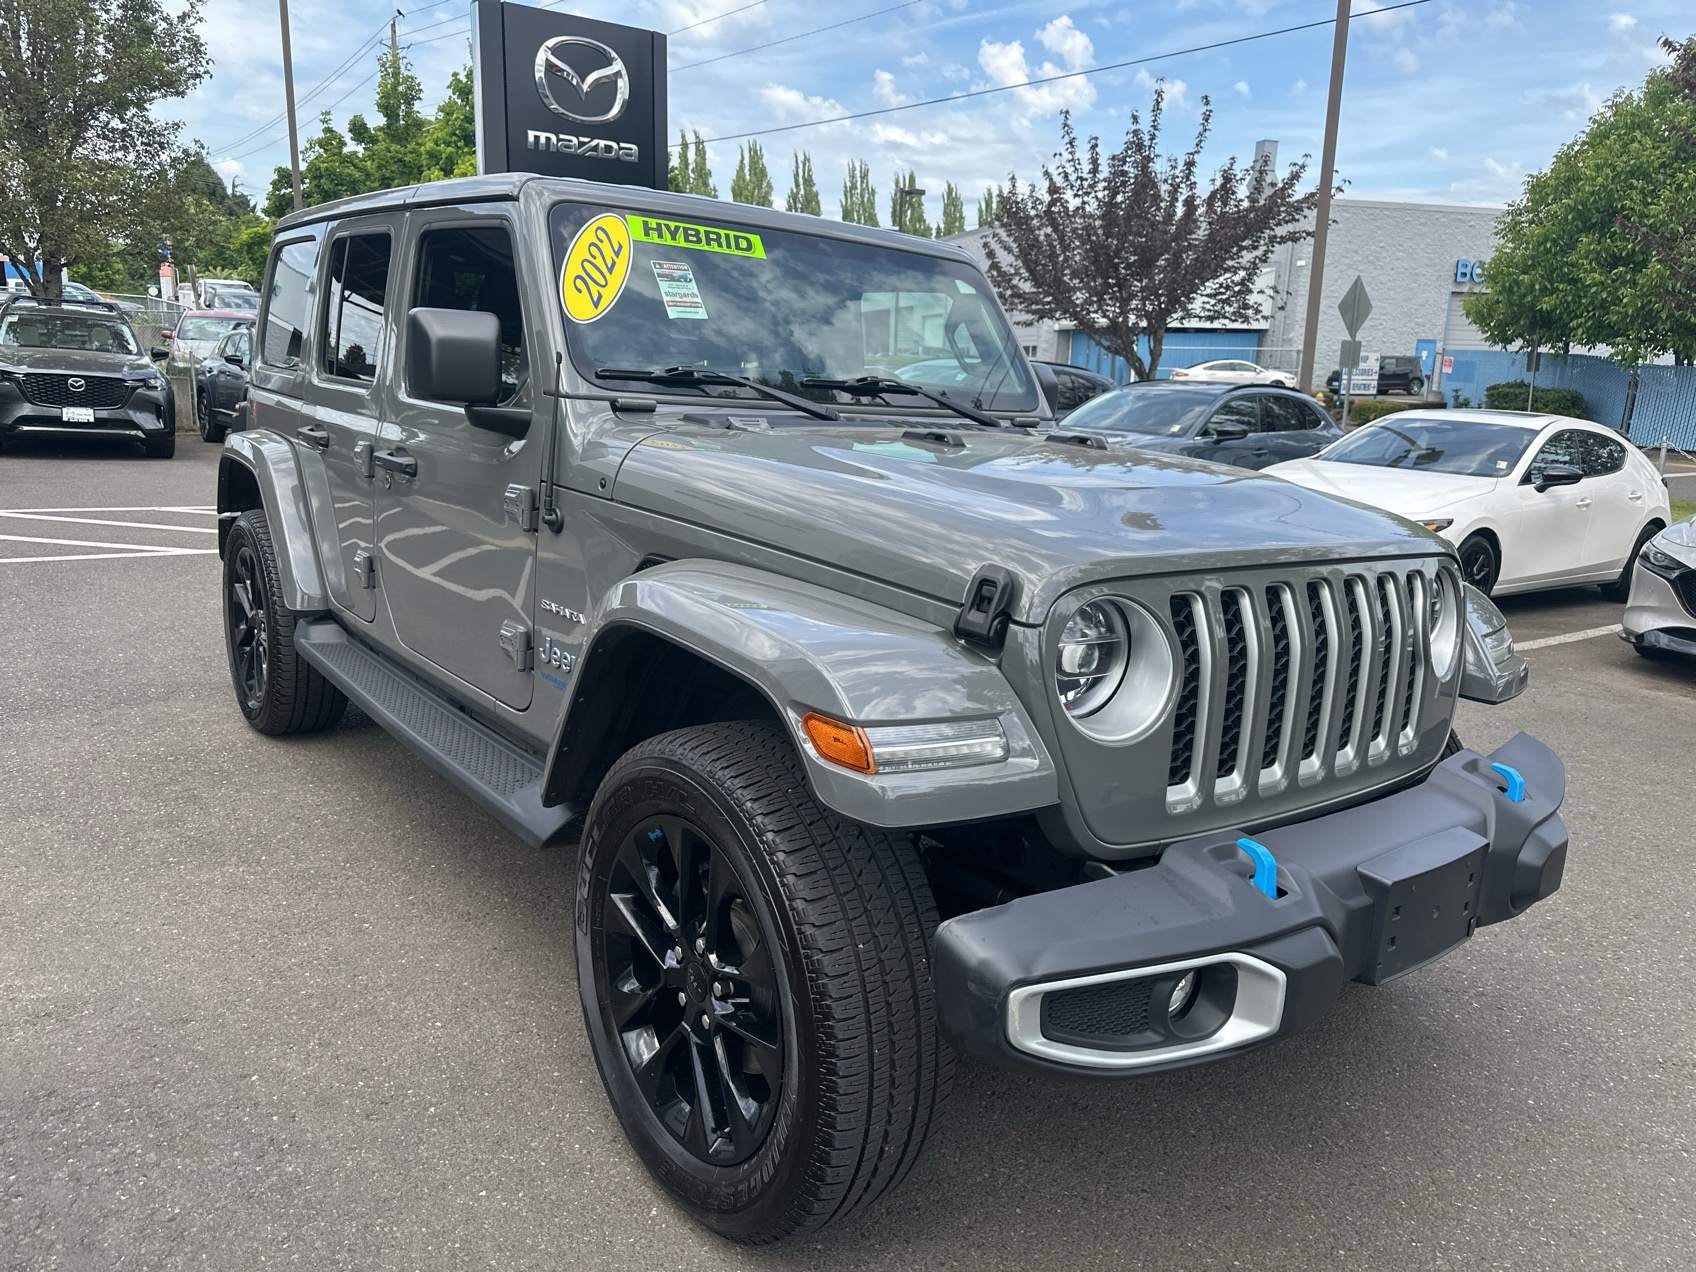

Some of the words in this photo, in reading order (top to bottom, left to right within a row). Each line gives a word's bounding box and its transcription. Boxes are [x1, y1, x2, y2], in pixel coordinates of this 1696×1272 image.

[641, 219, 755, 253] HYBRID
[573, 226, 624, 309] 2022
[1455, 259, 1485, 282] BO
[1343, 367, 1374, 377] AESSORIES
[540, 598, 587, 625] SAHARA
